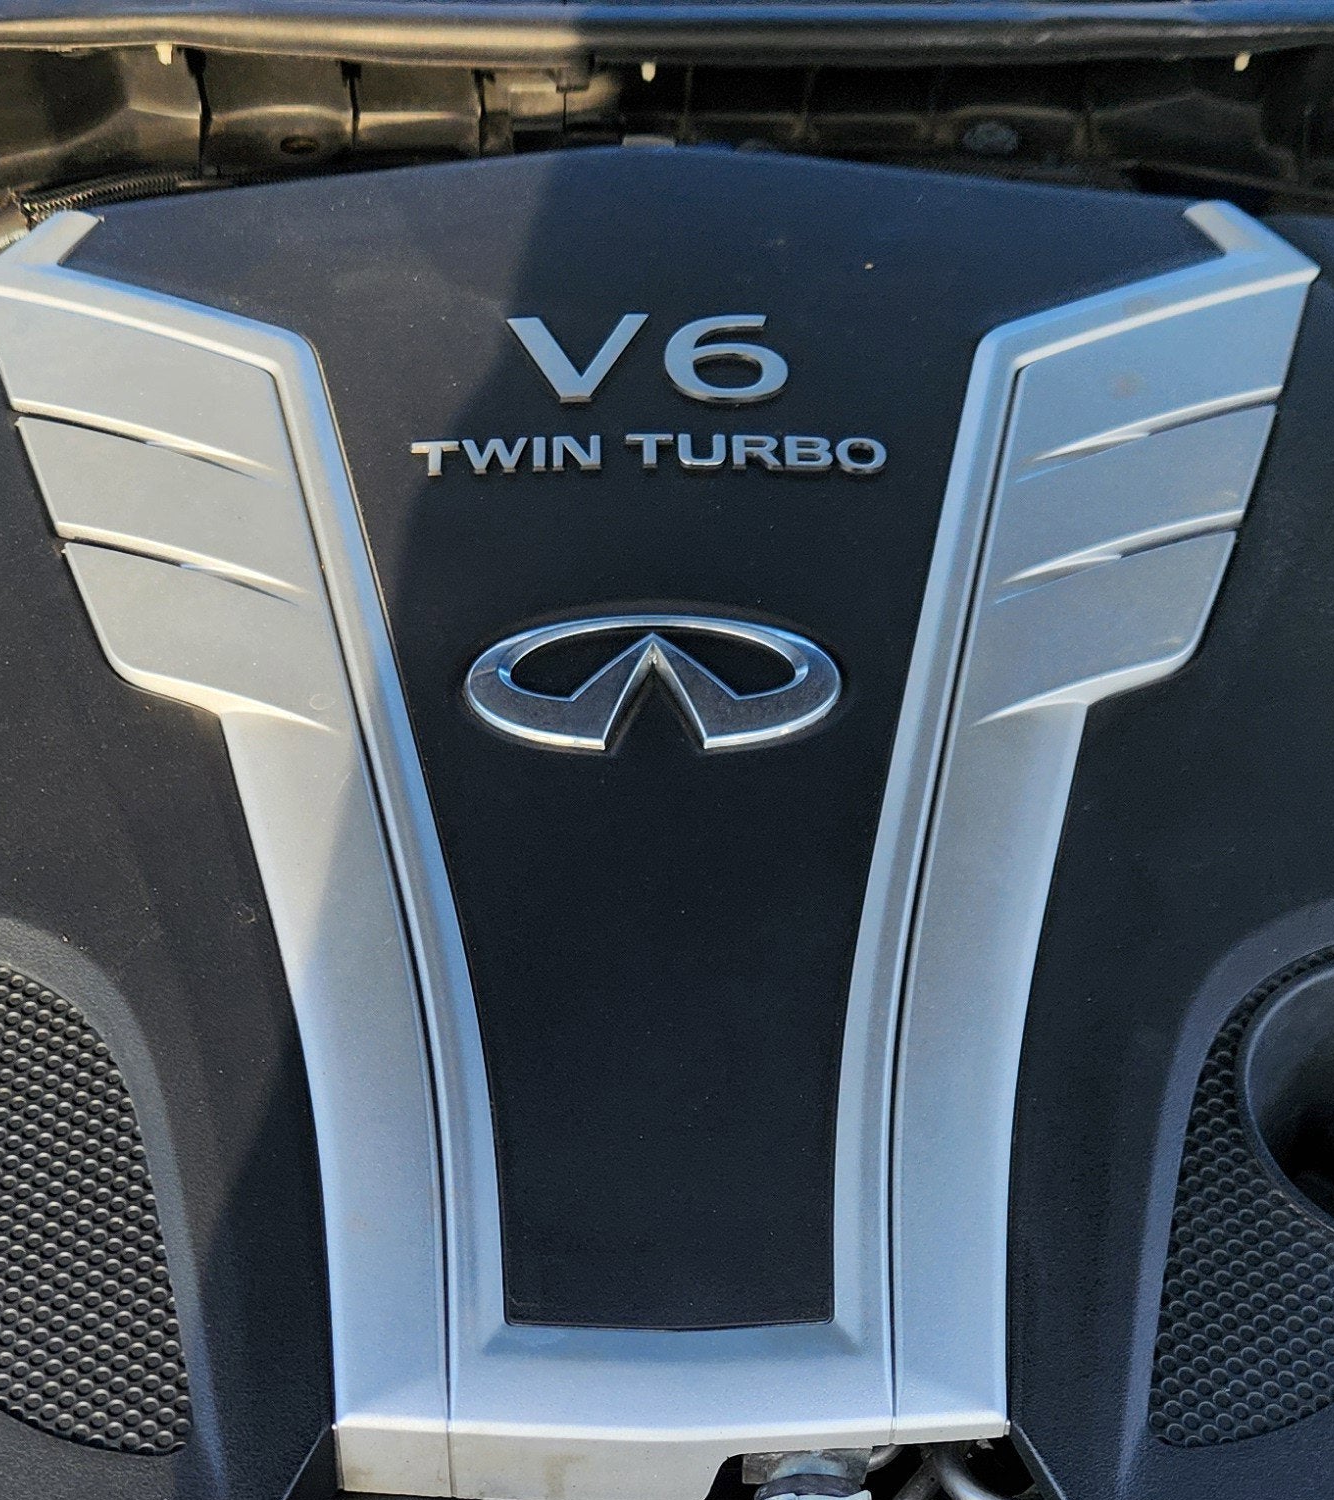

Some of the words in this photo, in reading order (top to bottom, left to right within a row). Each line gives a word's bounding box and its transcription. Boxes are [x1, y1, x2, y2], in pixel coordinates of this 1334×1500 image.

[506, 312, 790, 404] V6
[411, 434, 603, 477] TWIN
[626, 432, 888, 475] TURBO
